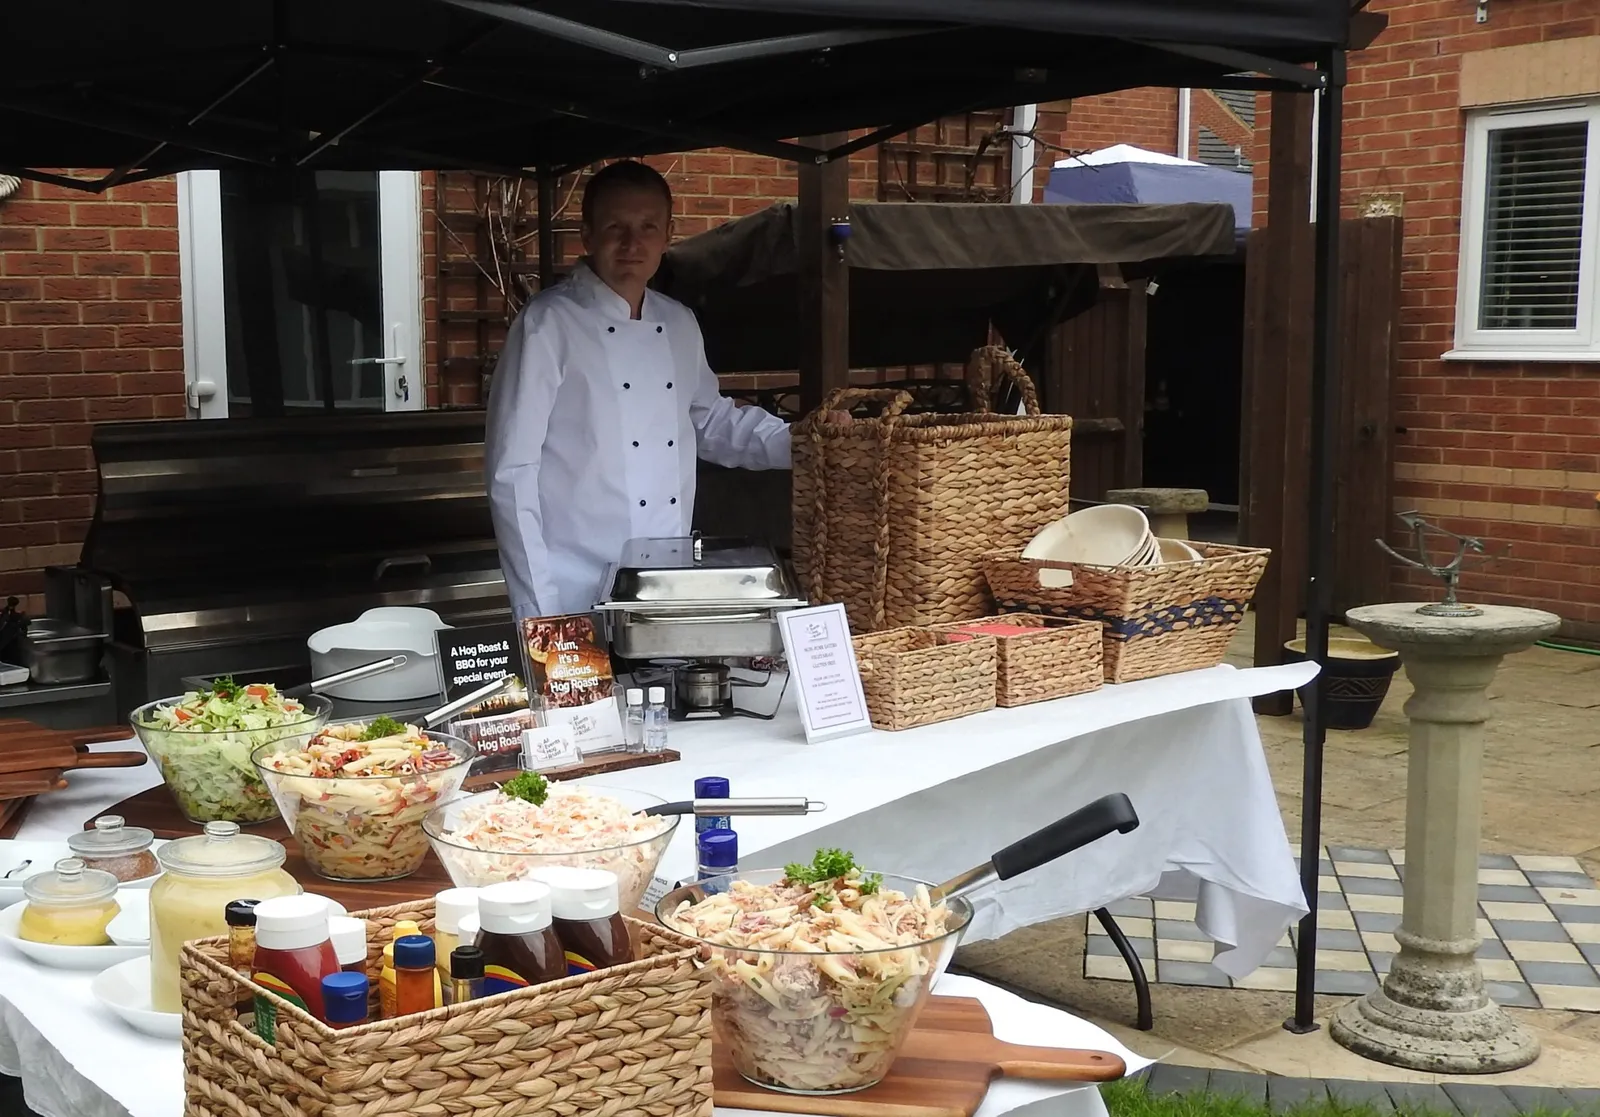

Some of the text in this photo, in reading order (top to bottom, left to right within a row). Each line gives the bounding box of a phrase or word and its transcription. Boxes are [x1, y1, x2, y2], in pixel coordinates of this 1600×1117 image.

[451, 640, 509, 657] A Hog Roast &
[554, 641, 579, 652] Yum,
[455, 656, 509, 671] BBQ for your
[558, 653, 580, 664] it's a
[453, 671, 483, 686] special
[549, 676, 598, 693] Hog Roast!
[479, 721, 521, 736] delicious
[476, 735, 523, 752] Hog Roas
